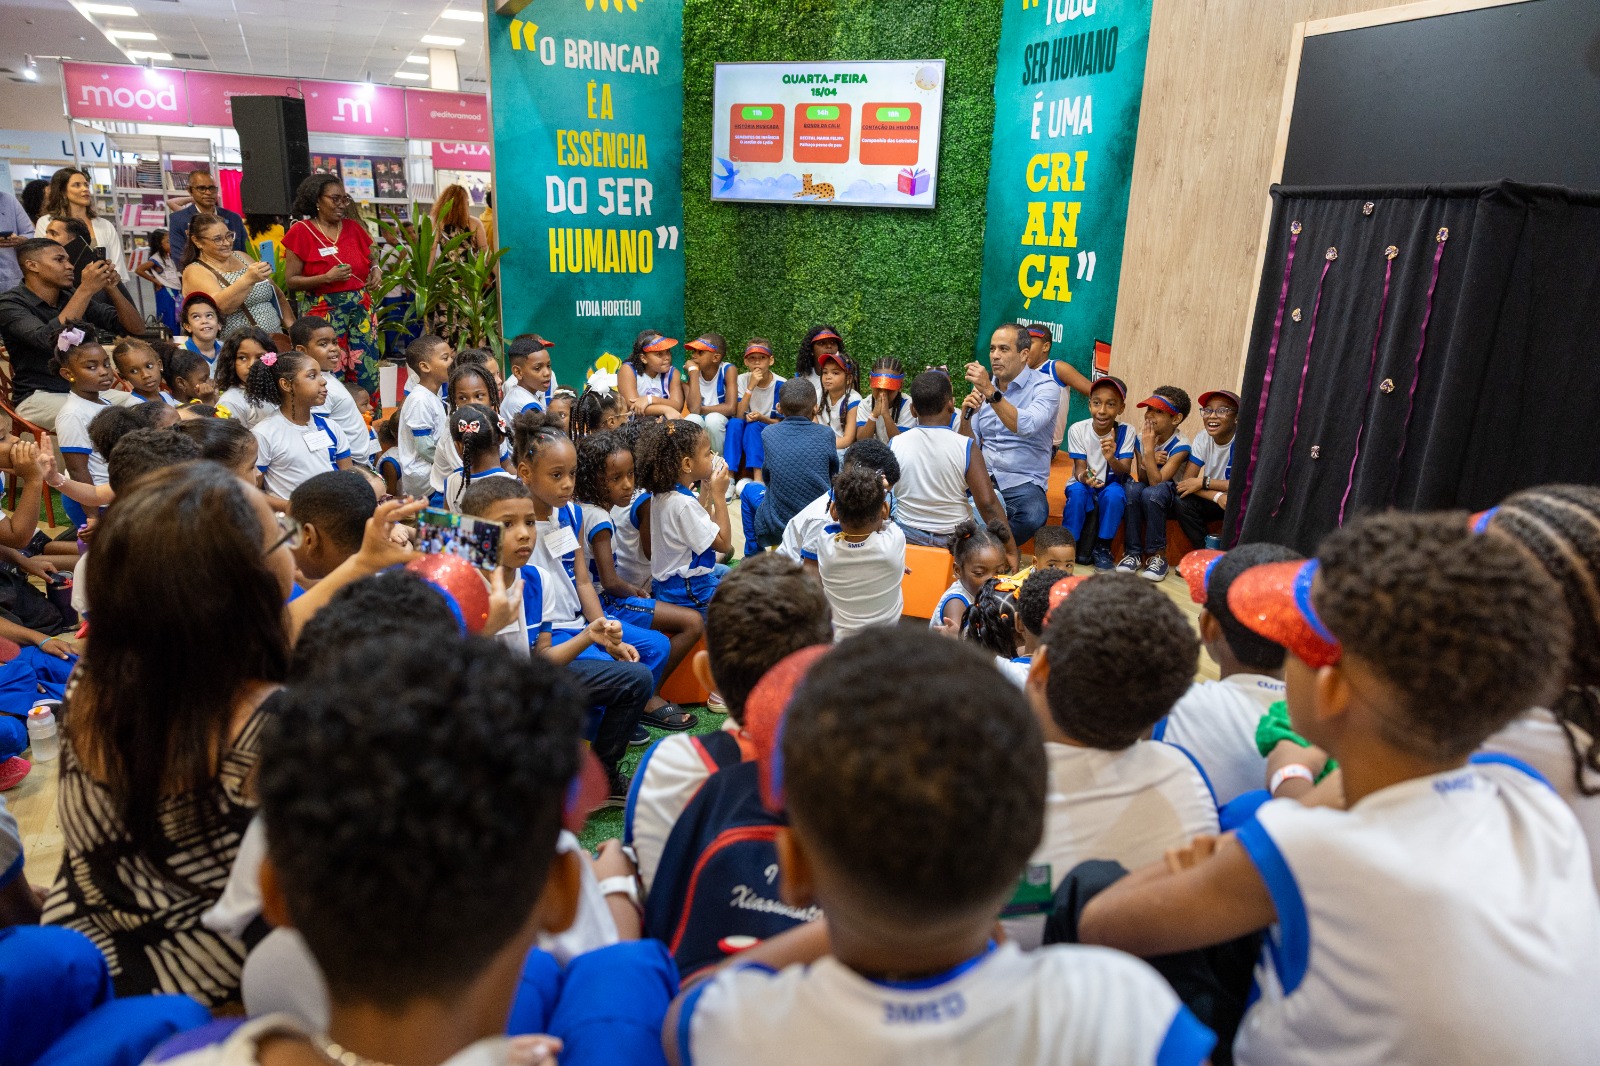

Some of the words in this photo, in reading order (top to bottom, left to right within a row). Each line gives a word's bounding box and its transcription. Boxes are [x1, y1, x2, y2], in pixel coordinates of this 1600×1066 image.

[564, 38, 660, 75] BRINCAR
[1022, 40, 1050, 86] SER
[1049, 25, 1119, 82] HUMANO
[79, 84, 178, 111] mood
[782, 73, 868, 84] QUARTA-FEIRA
[810, 87, 838, 98] 15/04
[430, 110, 482, 121] @editoramood
[587, 79, 598, 119] É
[601, 83, 614, 120] A
[1030, 90, 1044, 140] É
[1048, 95, 1093, 139] UMA
[556, 128, 649, 170] ESSÊNCIA
[1025, 150, 1089, 193] CRI
[545, 175, 588, 215] DO
[598, 176, 653, 216] SER
[1021, 201, 1081, 248] AN
[575, 300, 601, 317] LYDIA
[601, 298, 642, 317] HORTÉLIO
